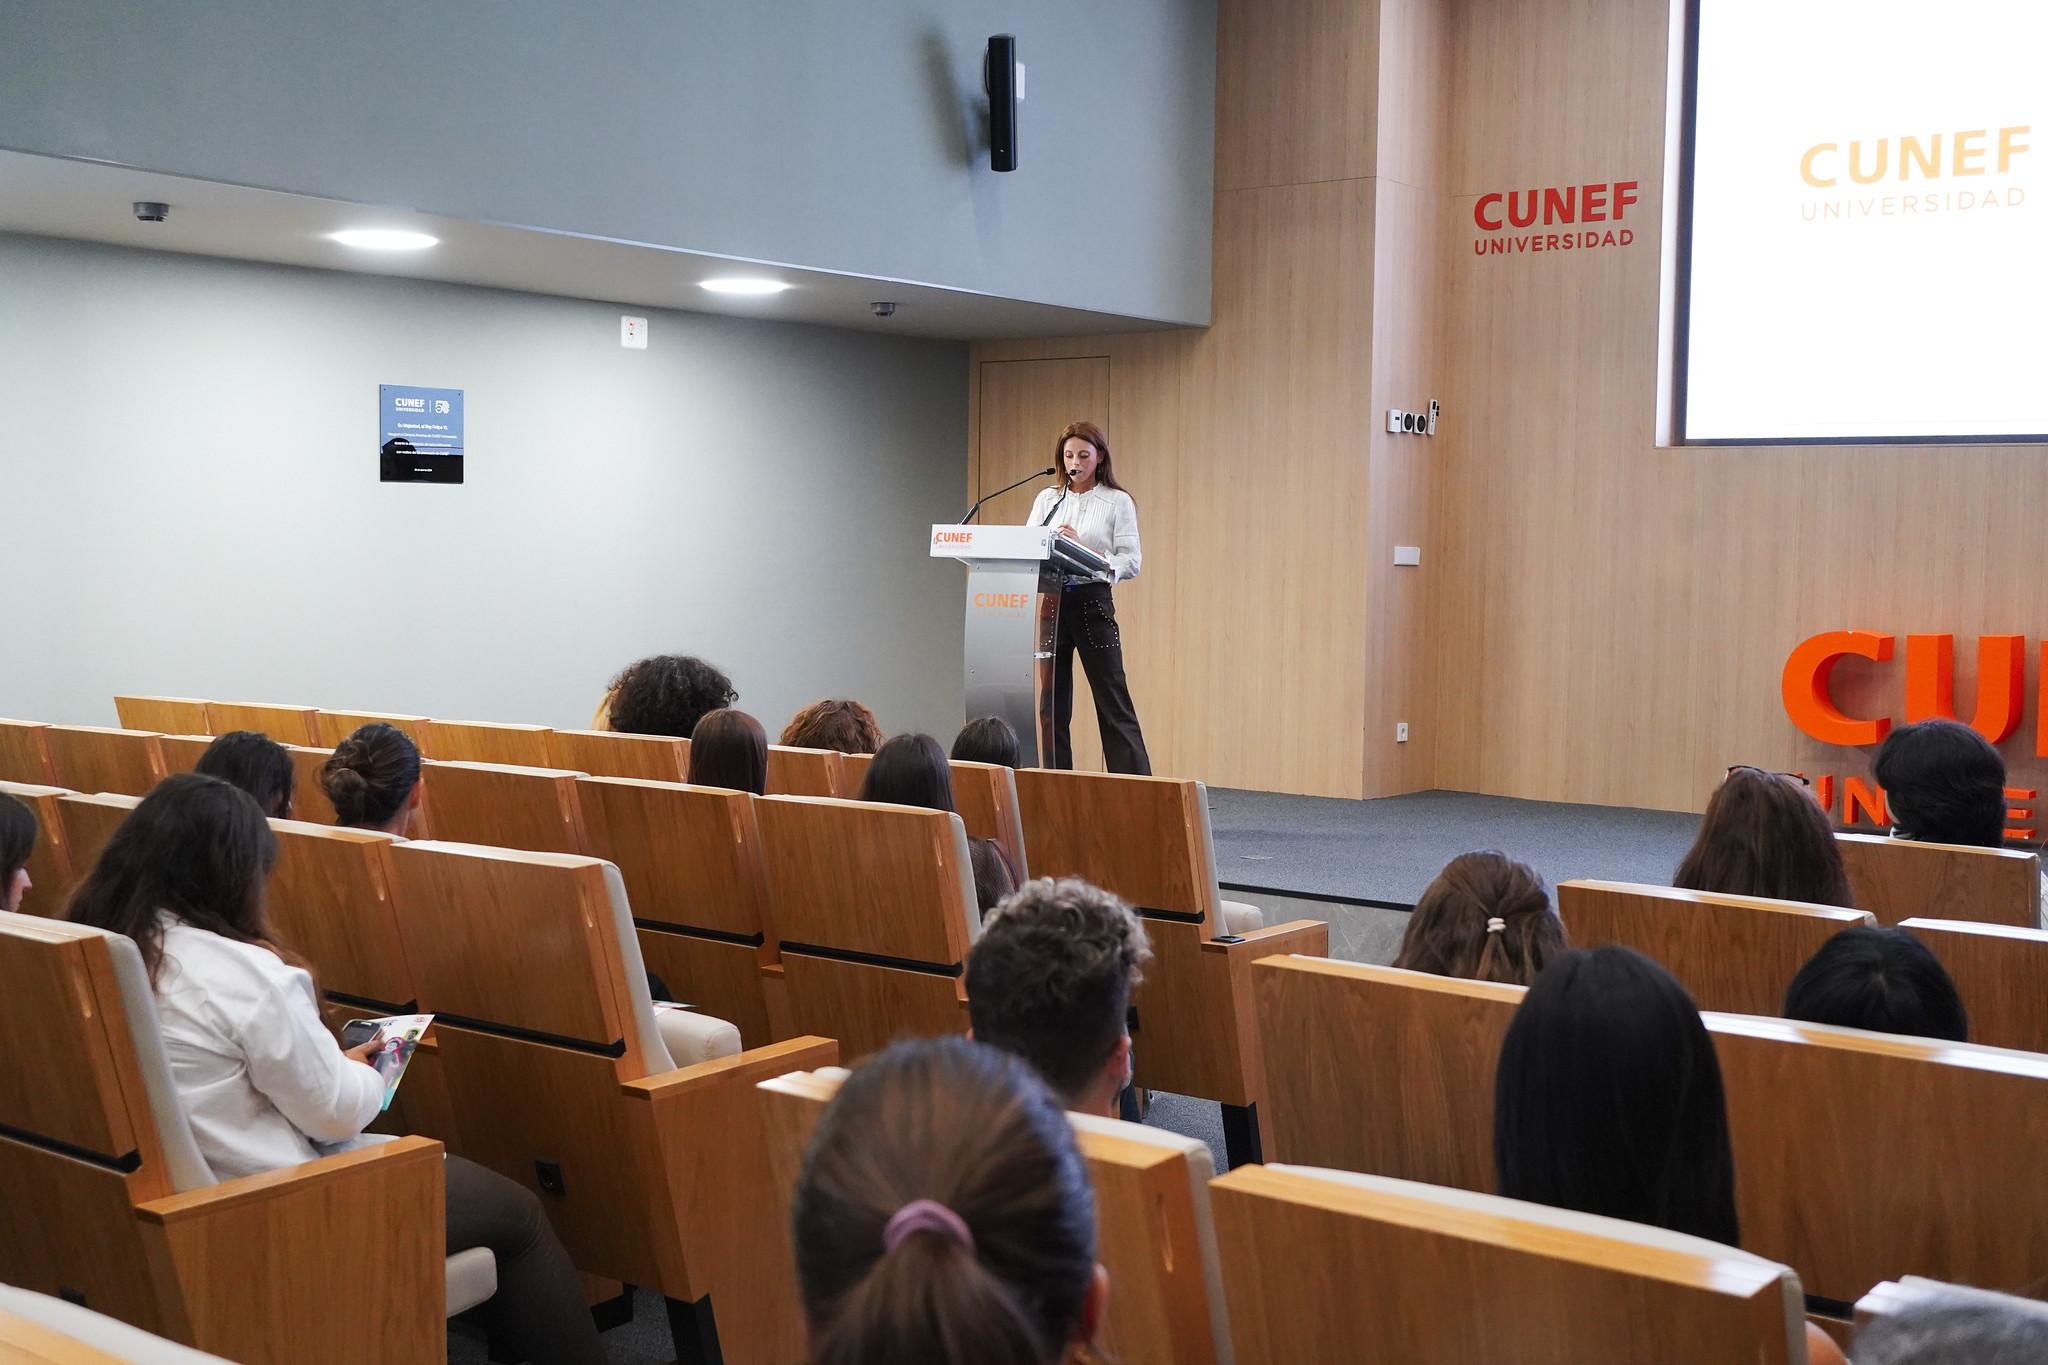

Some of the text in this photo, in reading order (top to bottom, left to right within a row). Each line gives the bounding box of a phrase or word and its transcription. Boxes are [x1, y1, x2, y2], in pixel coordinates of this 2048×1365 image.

[1800, 125, 2031, 188] CUNEF
[1474, 181, 1638, 231] CUNEF
[1801, 187, 2026, 221] UNIVERSIDAD
[1474, 229, 1634, 256] UNIVERSIDAD
[395, 398, 425, 408] CUNEF
[935, 532, 973, 543] CUNEF
[974, 593, 1029, 608] CUNEF
[1782, 630, 2048, 757] CU
